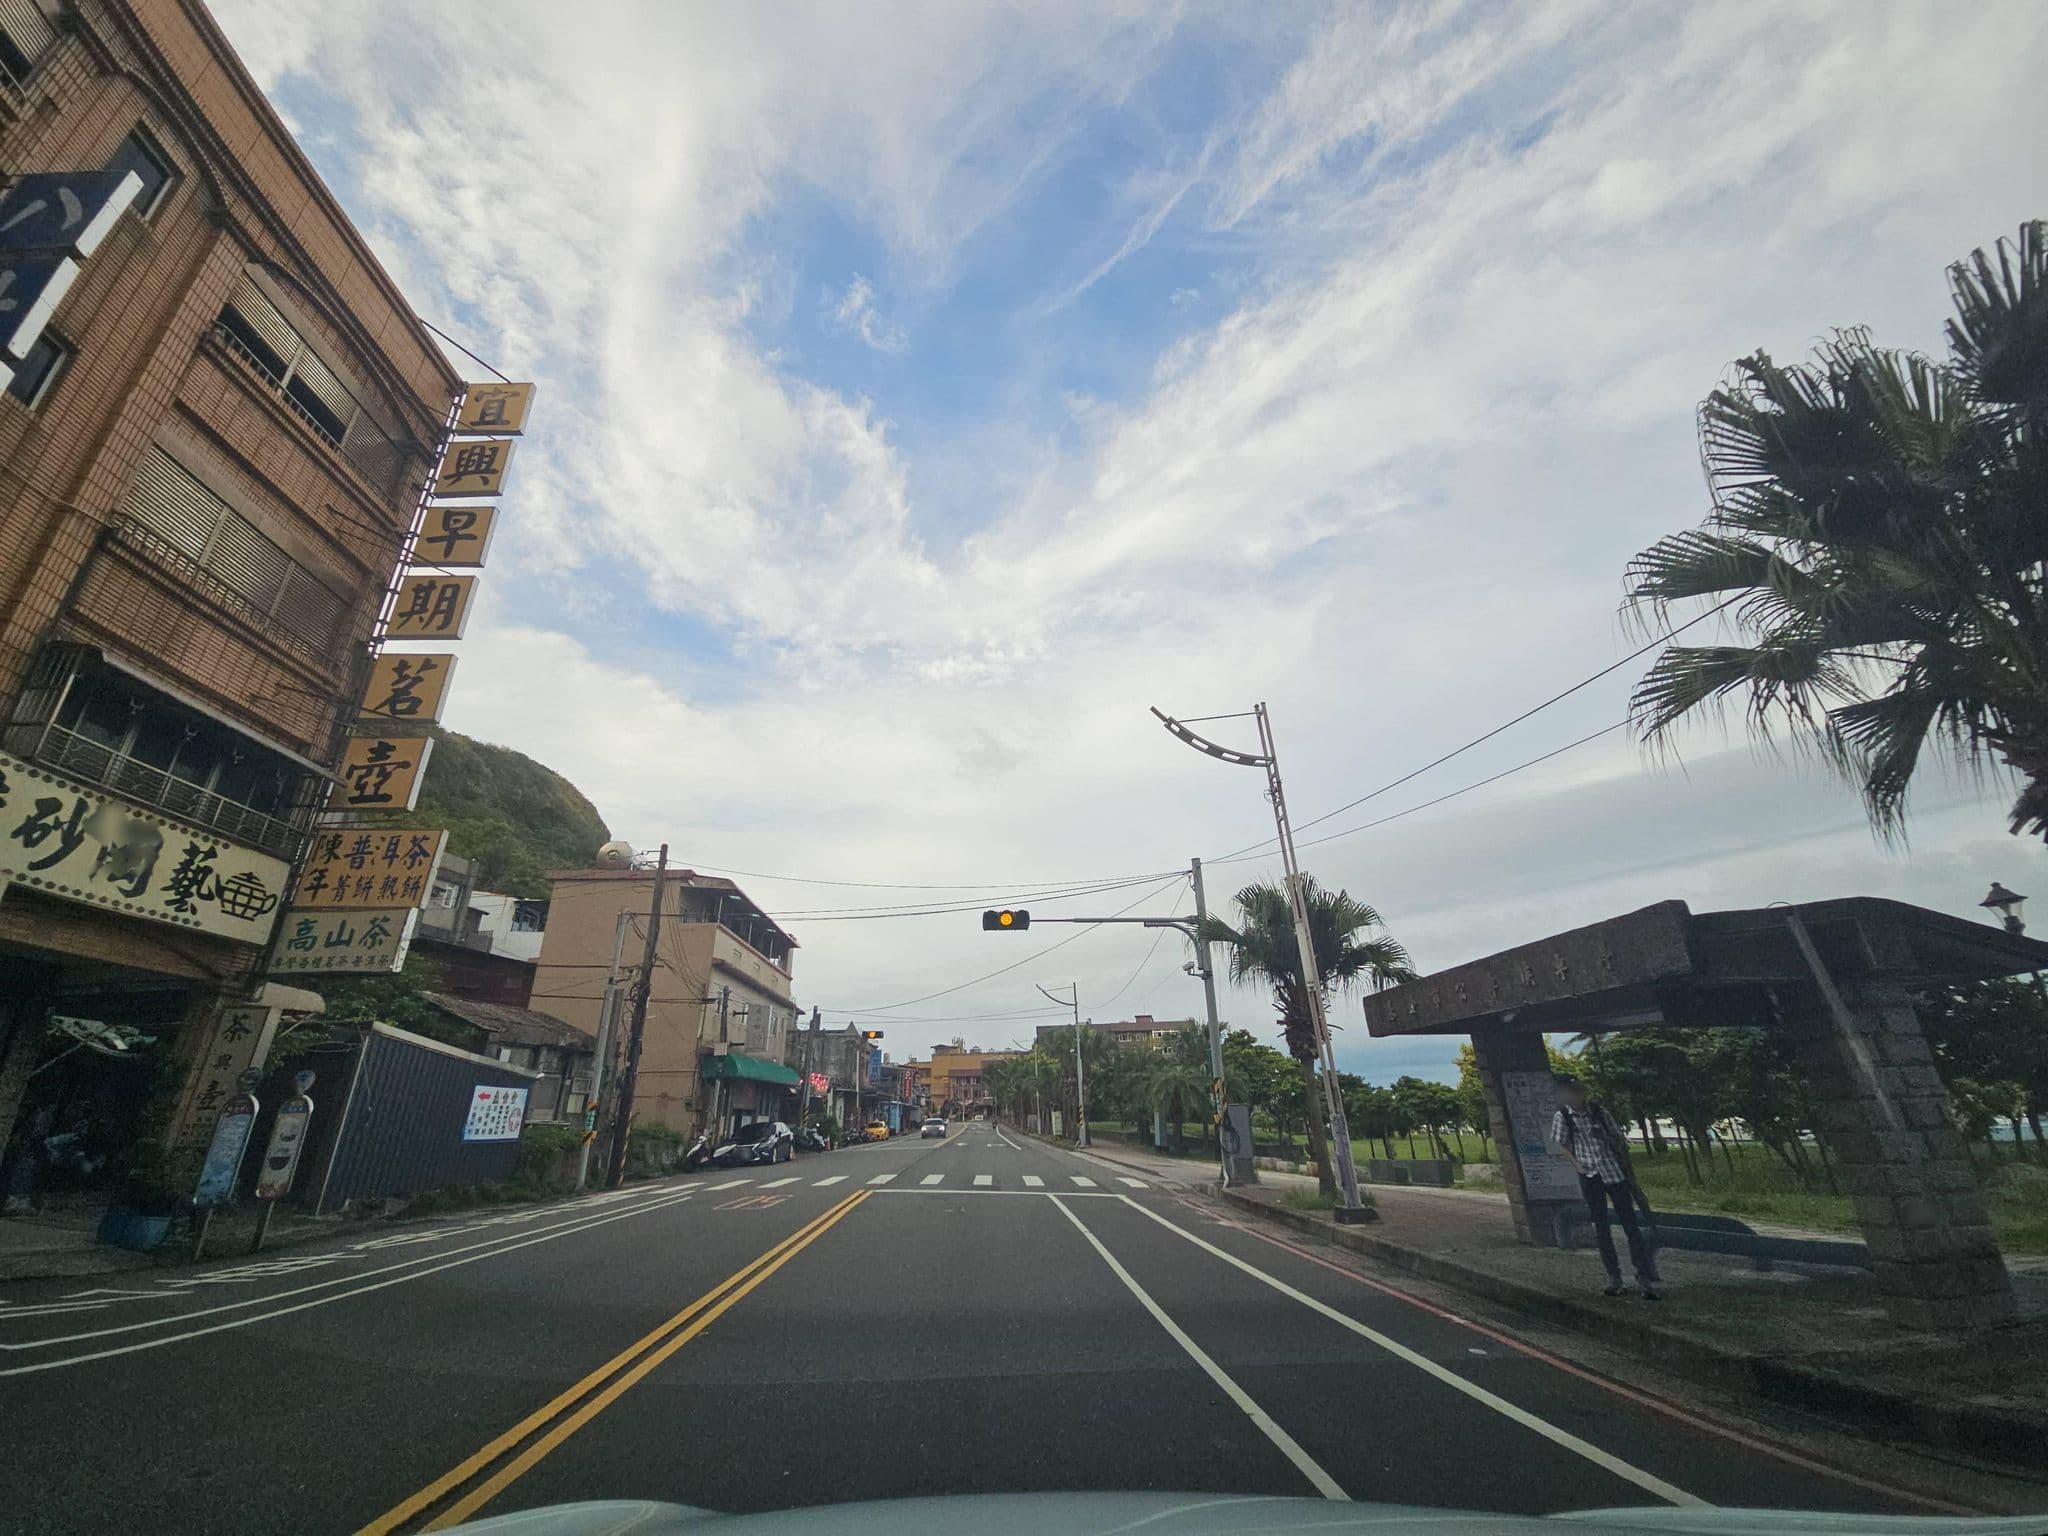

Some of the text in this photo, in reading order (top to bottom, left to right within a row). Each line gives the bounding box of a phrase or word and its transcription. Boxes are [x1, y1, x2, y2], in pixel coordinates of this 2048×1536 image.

[0, 768, 219, 916] 砂藝
[343, 834, 431, 870] 普洱茶
[287, 916, 392, 951] 高山茶
